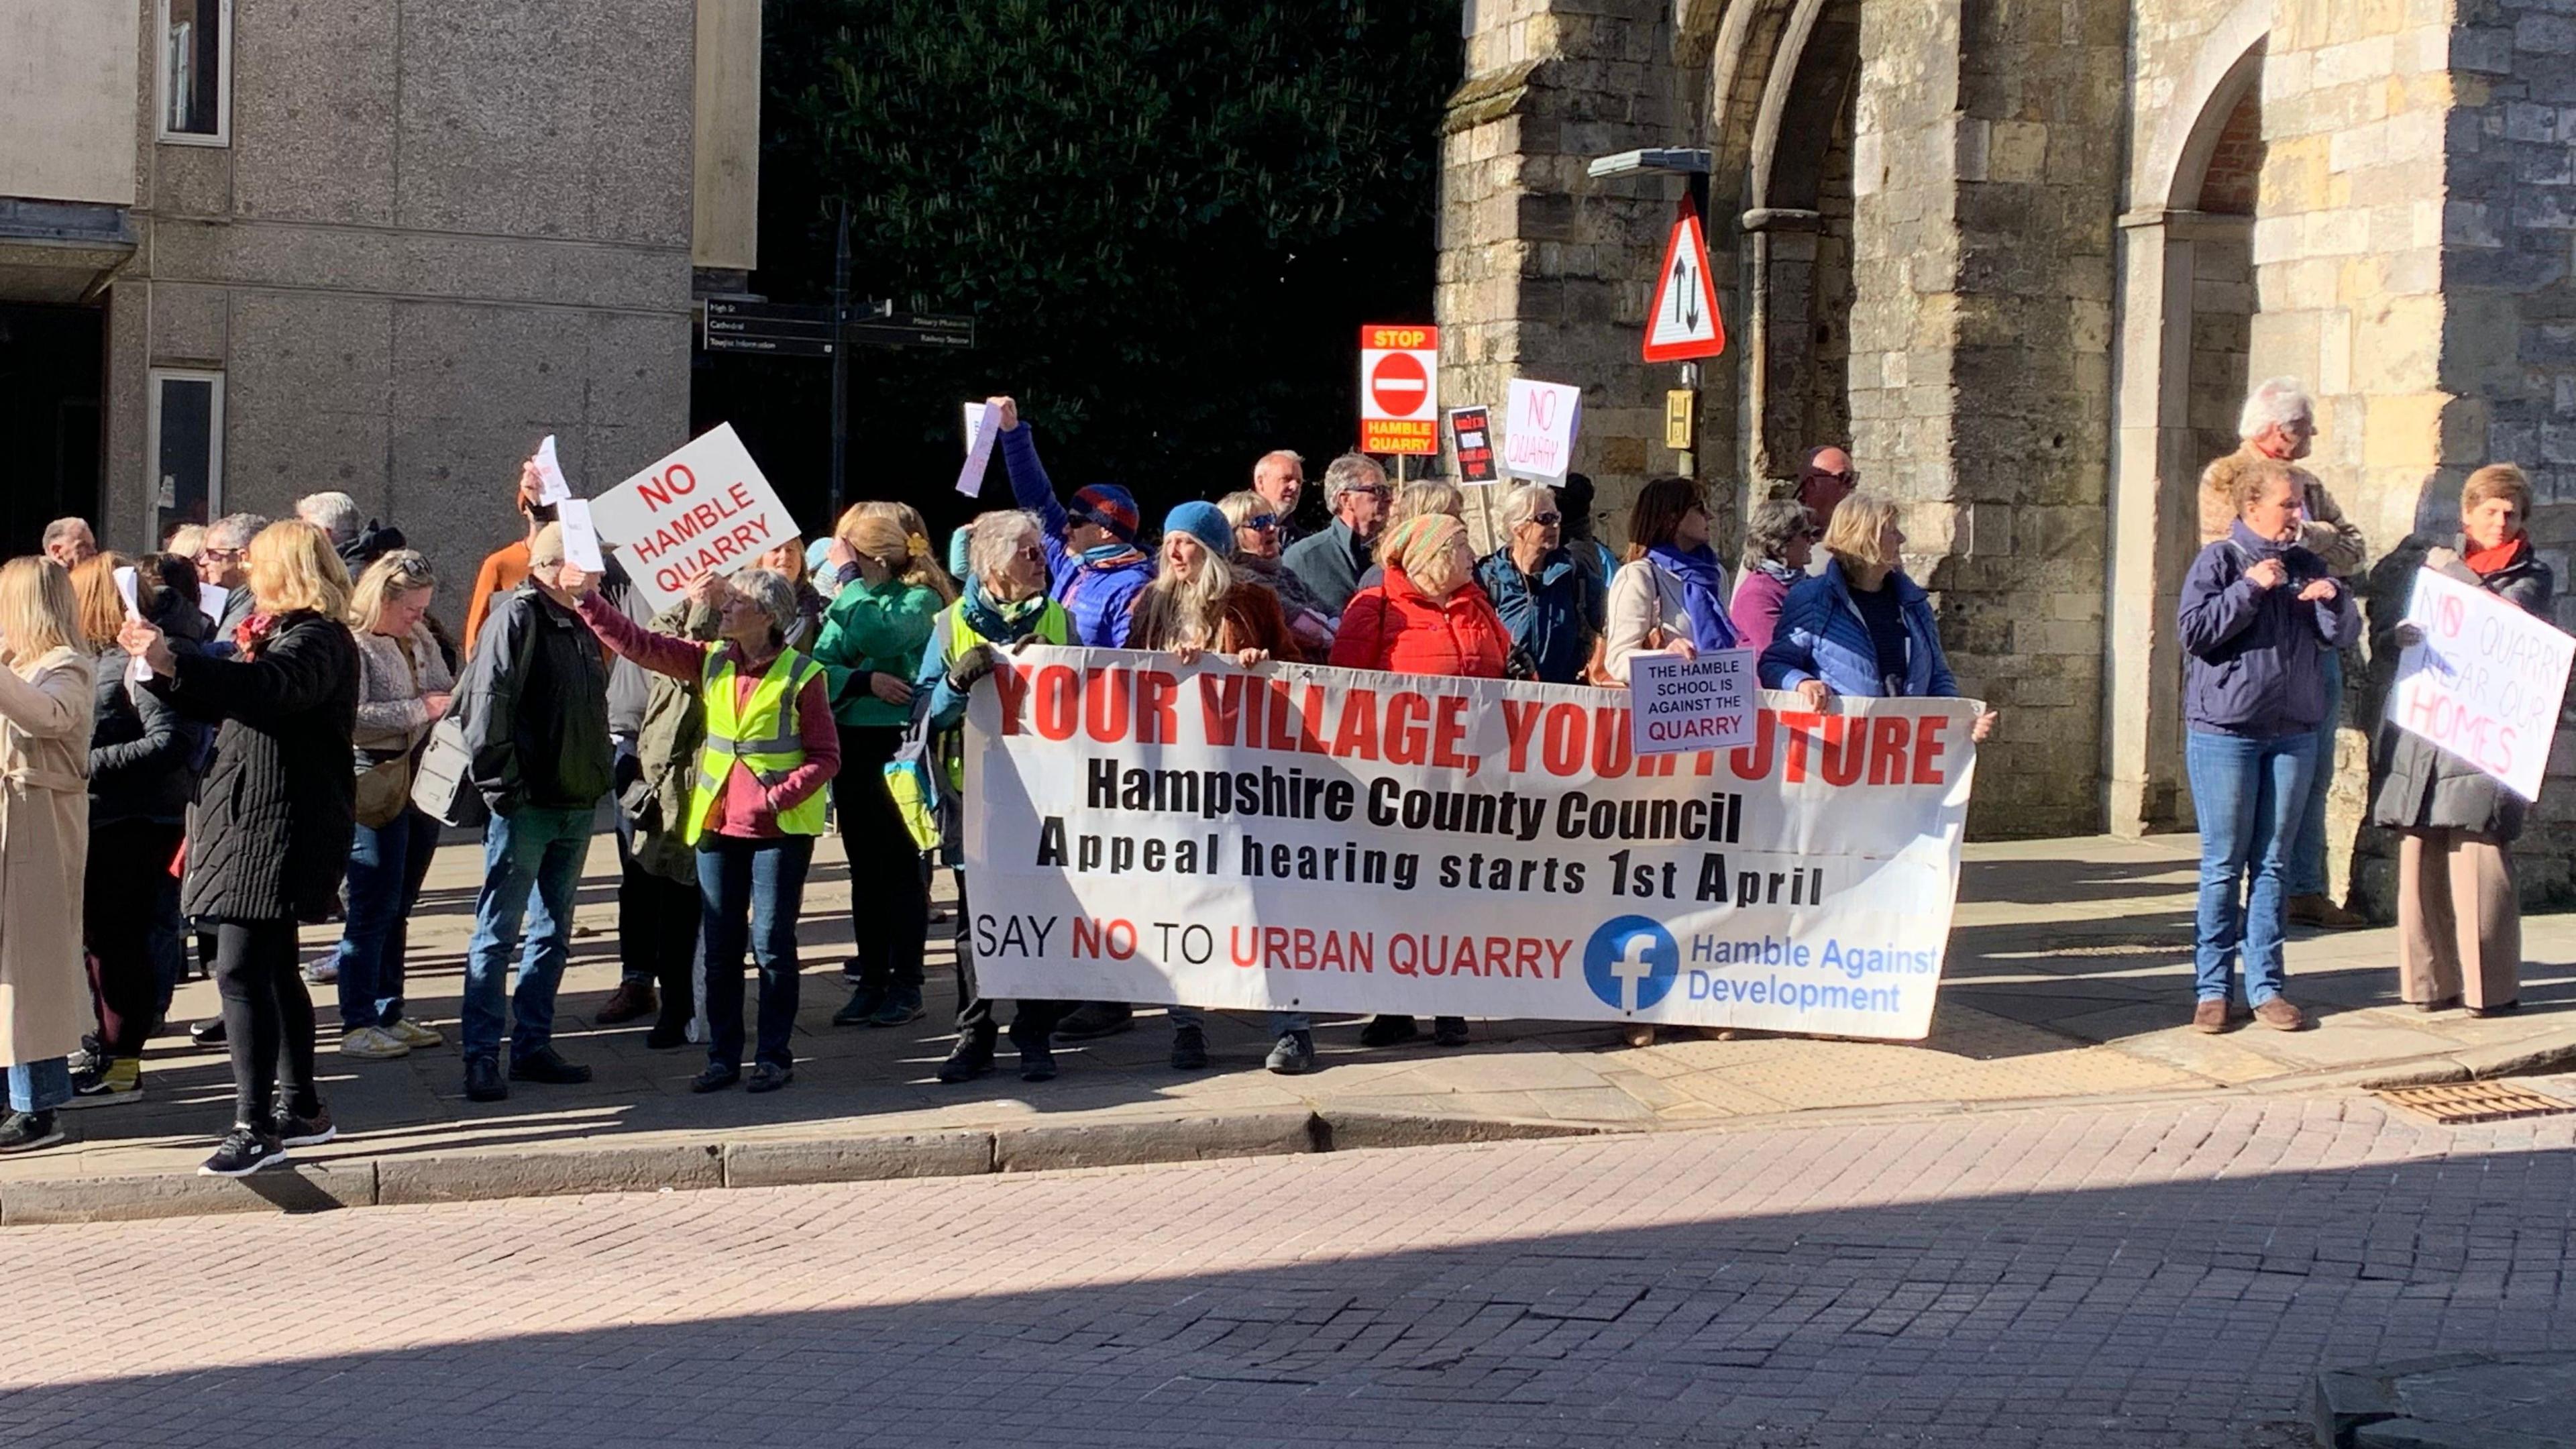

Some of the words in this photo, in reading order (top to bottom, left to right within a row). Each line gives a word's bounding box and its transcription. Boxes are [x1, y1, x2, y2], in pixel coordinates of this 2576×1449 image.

[1374, 330, 1426, 347] STOP
[1368, 422, 1432, 435] HAMBLE
[1527, 388, 1556, 431] NO
[1369, 437, 1431, 451] QUARRY
[1509, 433, 1559, 470] QUARRY
[637, 464, 696, 513] NO
[633, 482, 755, 565] HAMBLE
[655, 513, 771, 592] QUARRY
[2419, 586, 2464, 638] NO
[2481, 616, 2569, 692] QUARRY
[1648, 663, 1677, 678] THE
[1680, 660, 1739, 676] HAMBLE
[1657, 680, 1715, 696] SCHOOL
[1720, 680, 1733, 692] IS
[2422, 648, 2489, 704] NEAR
[2500, 680, 2546, 734] OUR
[993, 663, 1178, 744] YOUR
[1199, 674, 1479, 778] VILLAGE,
[1648, 697, 1712, 714] AGAINST
[1715, 696, 1741, 710] THE
[1648, 715, 1743, 741] QUARRY
[2408, 685, 2517, 773] HOMES
[1087, 758, 1354, 822] Hampshire
[1367, 777, 1546, 841] County
[1556, 791, 1742, 844] Council
[1037, 815, 1217, 875] Appeal
[1242, 834, 1419, 890] hearing
[1439, 852, 1586, 895] starts
[1609, 849, 1676, 900] 1st
[1697, 853, 1824, 908] April
[977, 914, 1057, 958] SAY
[1072, 918, 1137, 961] NO
[1152, 922, 1213, 965] TO
[1230, 926, 1374, 973] URBAN
[1389, 933, 1573, 979] QUARRY
[1692, 933, 1810, 967] Hamble
[1821, 938, 1937, 979] Against
[1688, 969, 1900, 1013] Development
